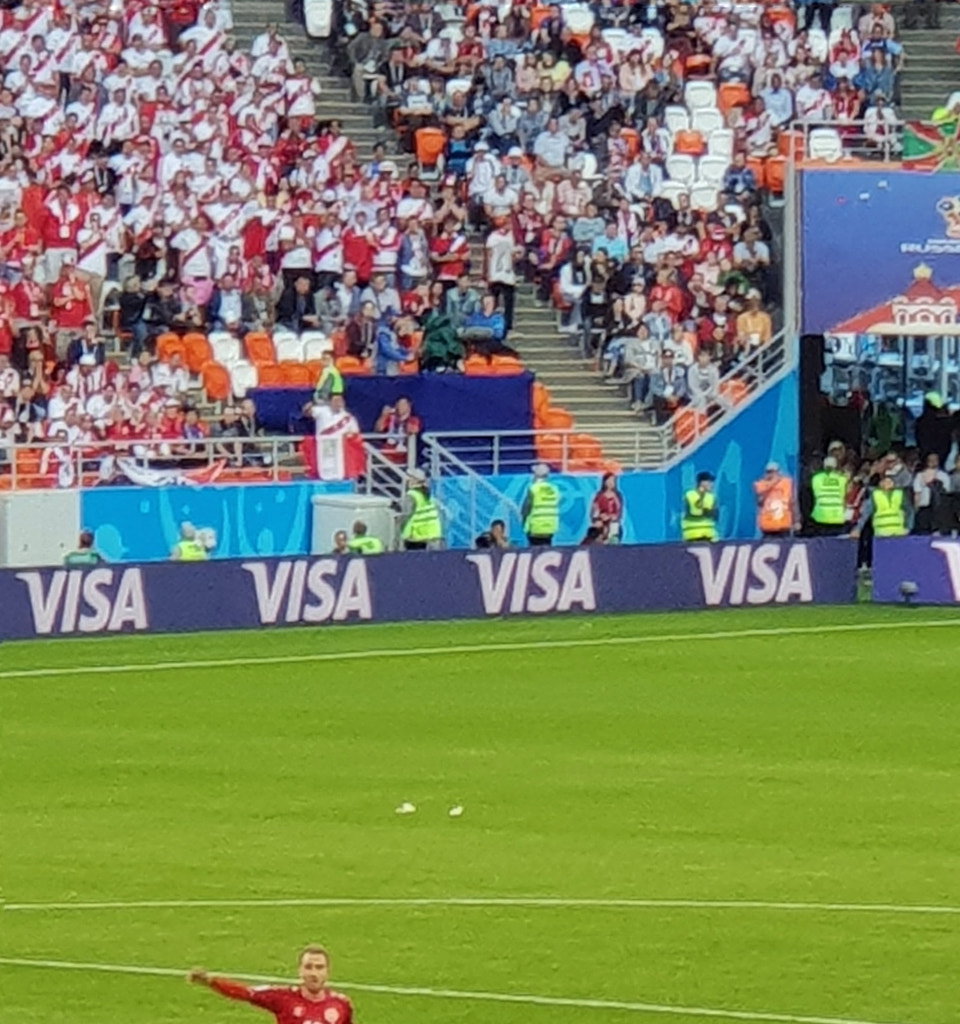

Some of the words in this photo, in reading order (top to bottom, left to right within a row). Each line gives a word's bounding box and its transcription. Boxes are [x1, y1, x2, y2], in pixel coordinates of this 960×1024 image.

[19, 566, 147, 634] VISA
[242, 558, 373, 624] VISA
[467, 549, 596, 614] VISA
[688, 542, 813, 606] VISA
